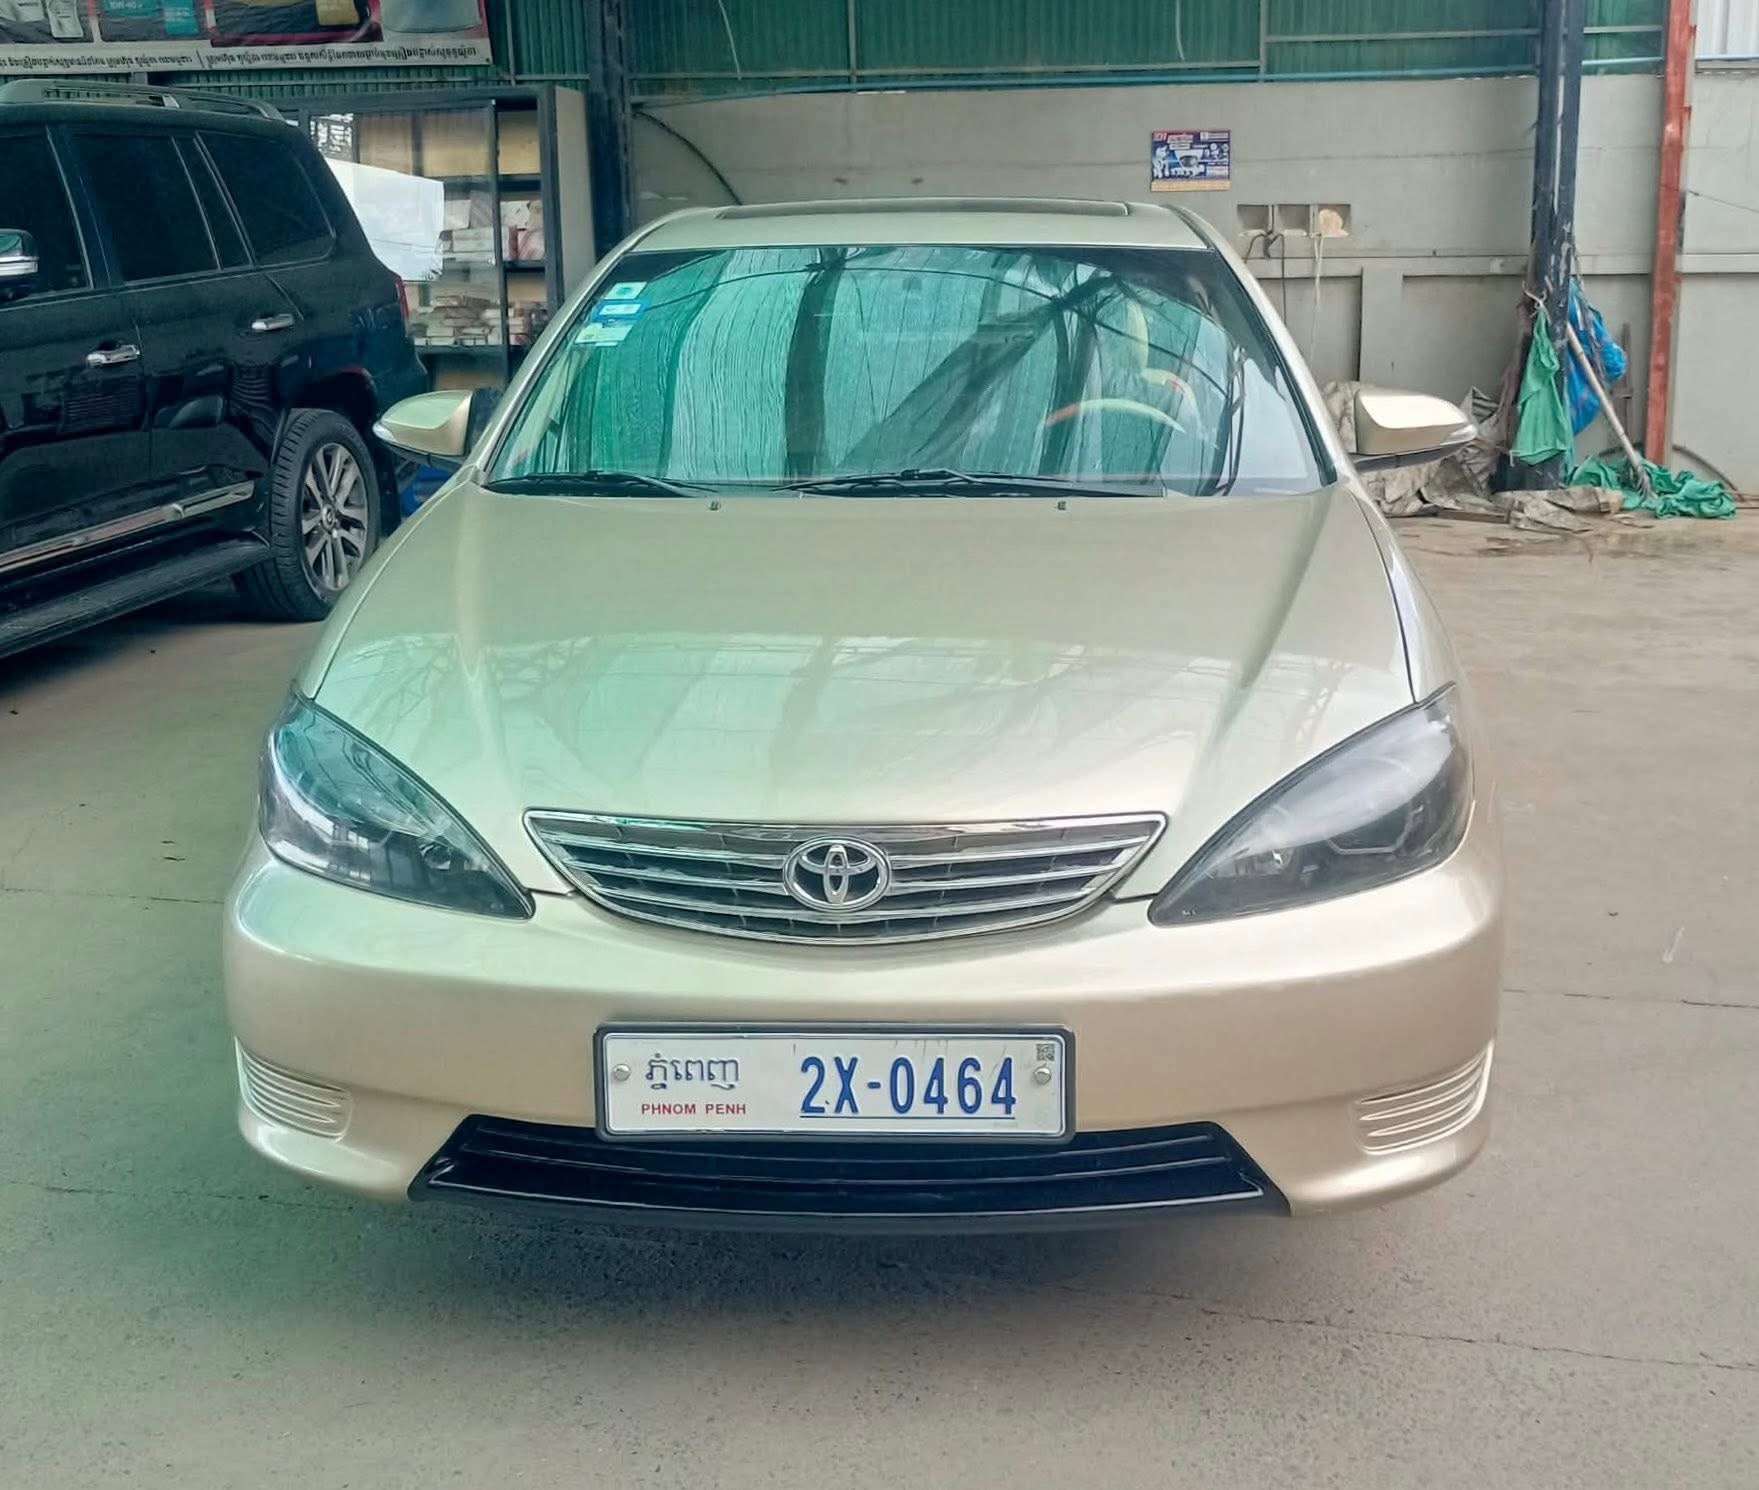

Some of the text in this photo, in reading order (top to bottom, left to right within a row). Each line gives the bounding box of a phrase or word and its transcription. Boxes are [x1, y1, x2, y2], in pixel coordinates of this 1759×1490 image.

[645, 1052, 739, 1090] ភ្នំពេញ
[800, 1056, 1016, 1114] 2X-0464
[641, 1103, 746, 1114] PHNOM PENH
